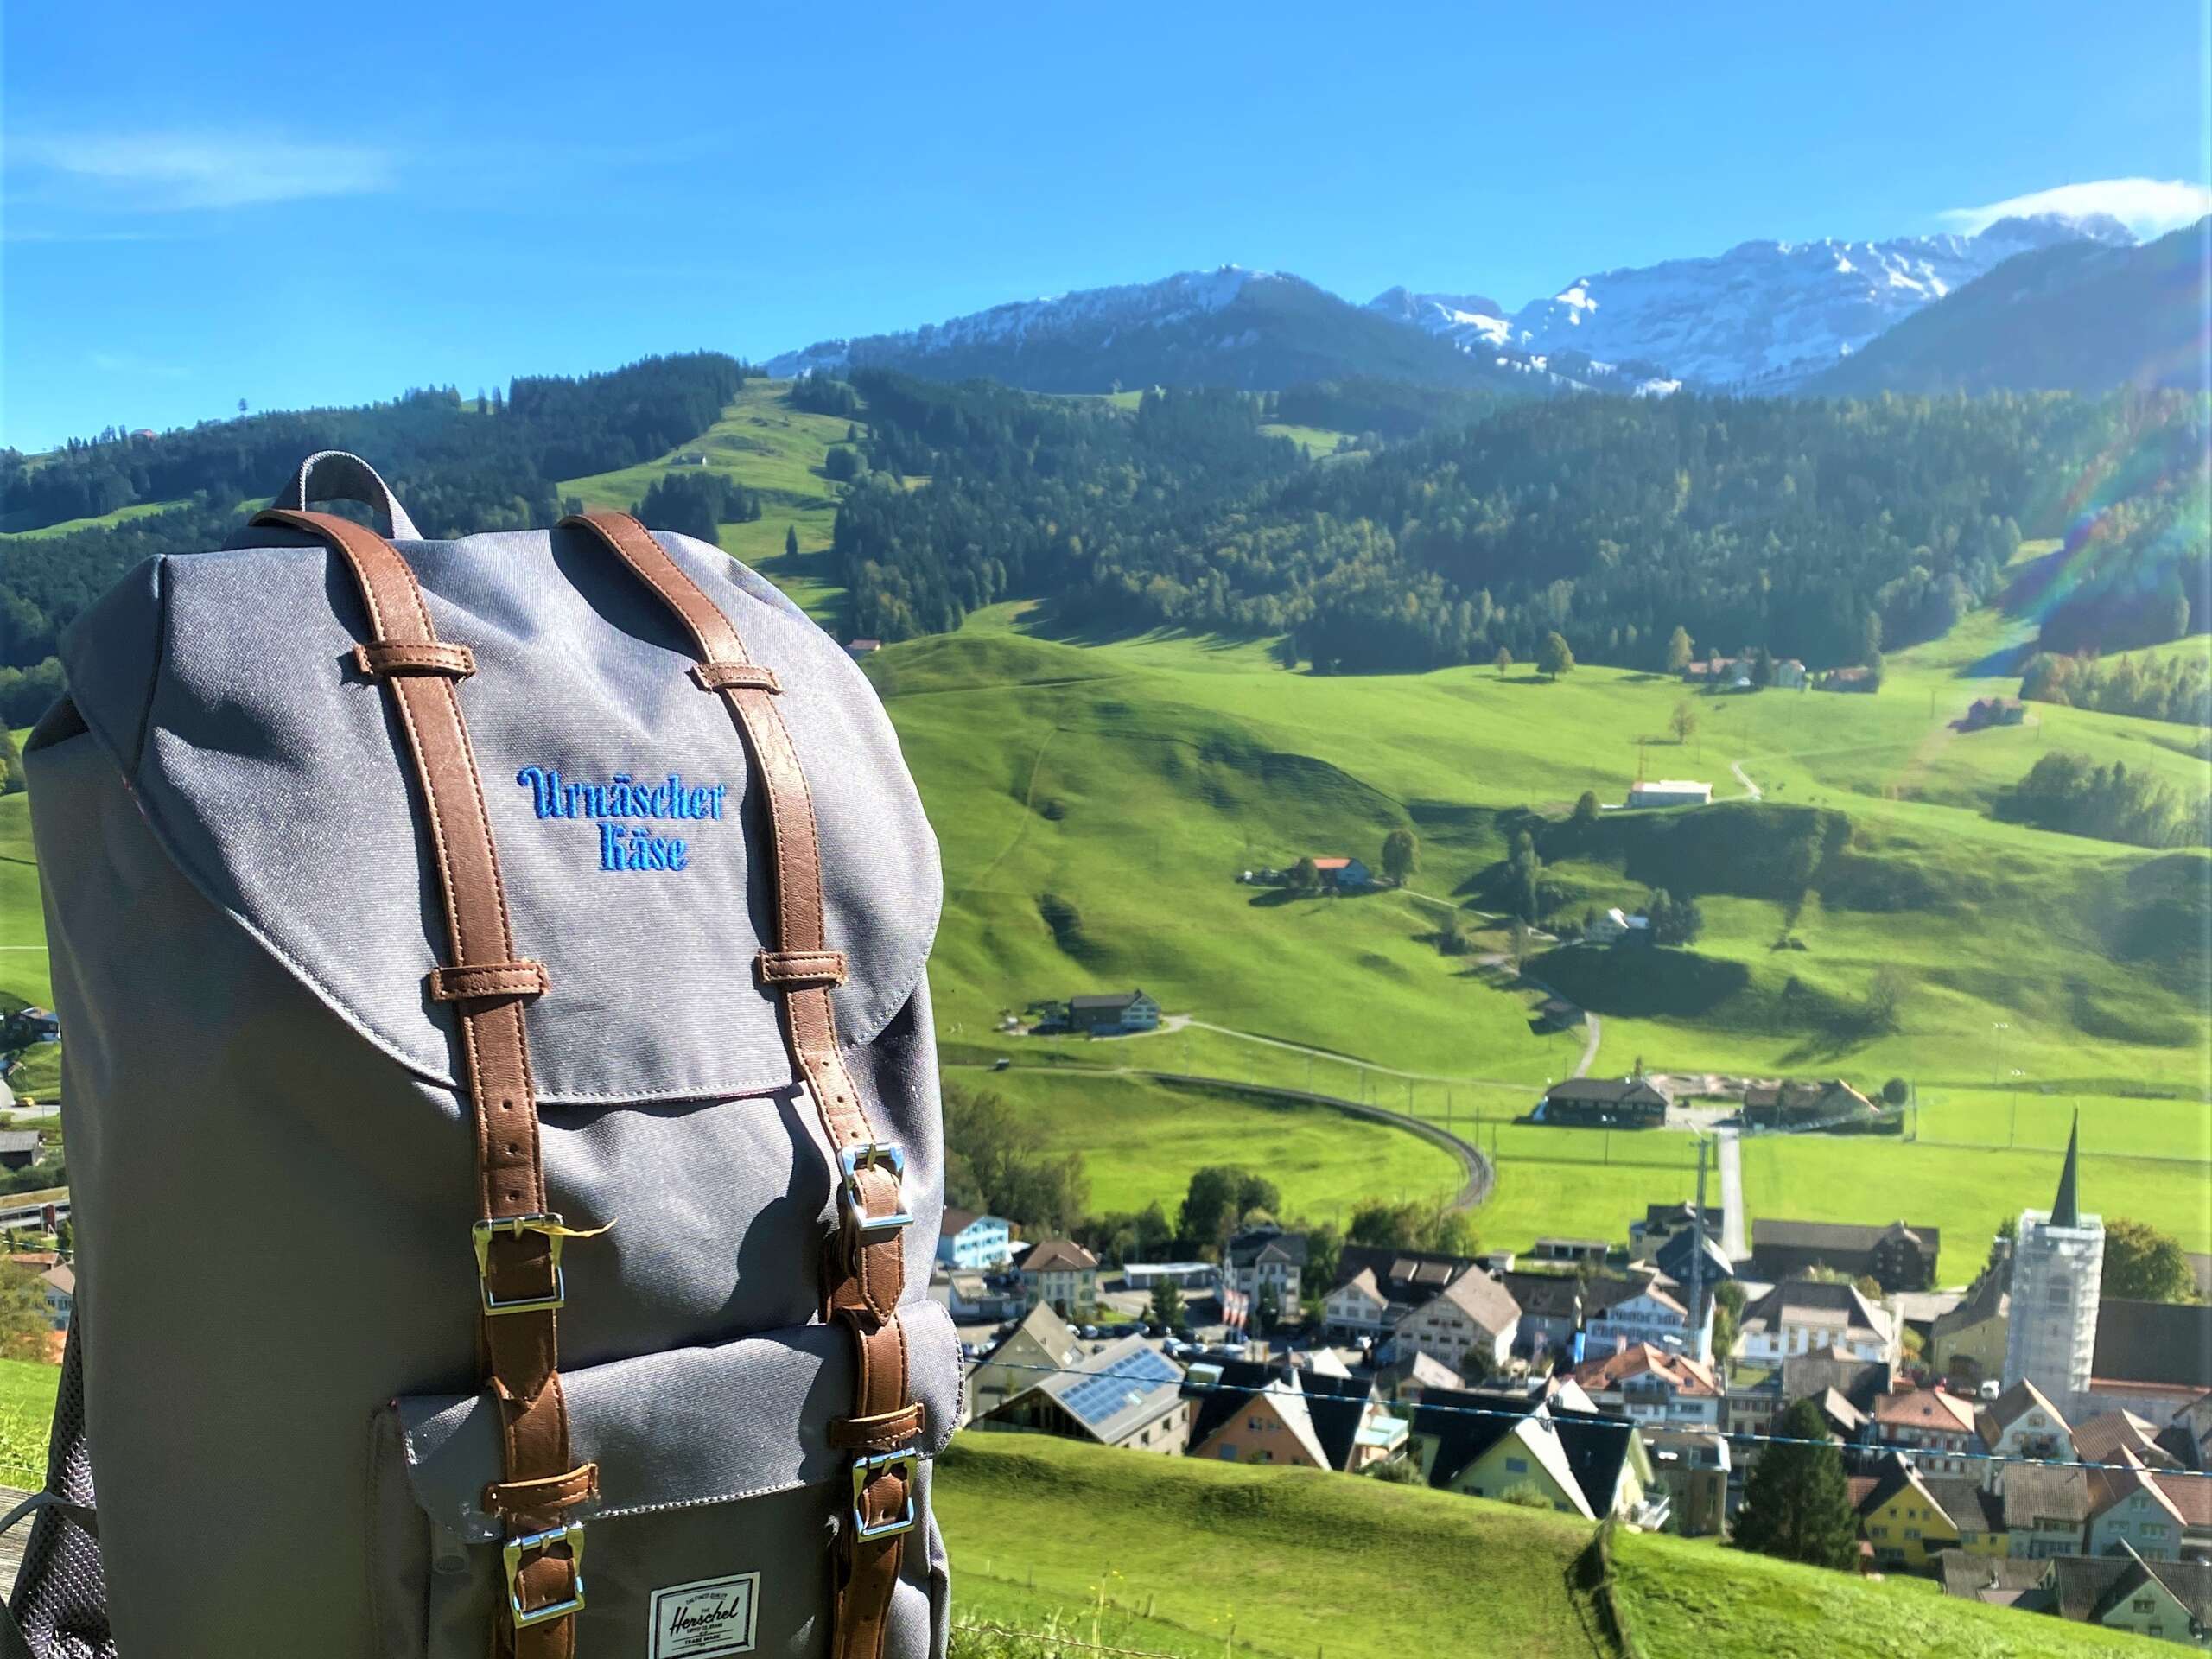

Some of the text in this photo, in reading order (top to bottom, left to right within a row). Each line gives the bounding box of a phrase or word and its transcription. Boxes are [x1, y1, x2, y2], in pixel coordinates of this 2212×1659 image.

[516, 766, 725, 820] Urnäscher
[597, 821, 689, 871] Käse
[669, 1596, 739, 1637] Herschel
